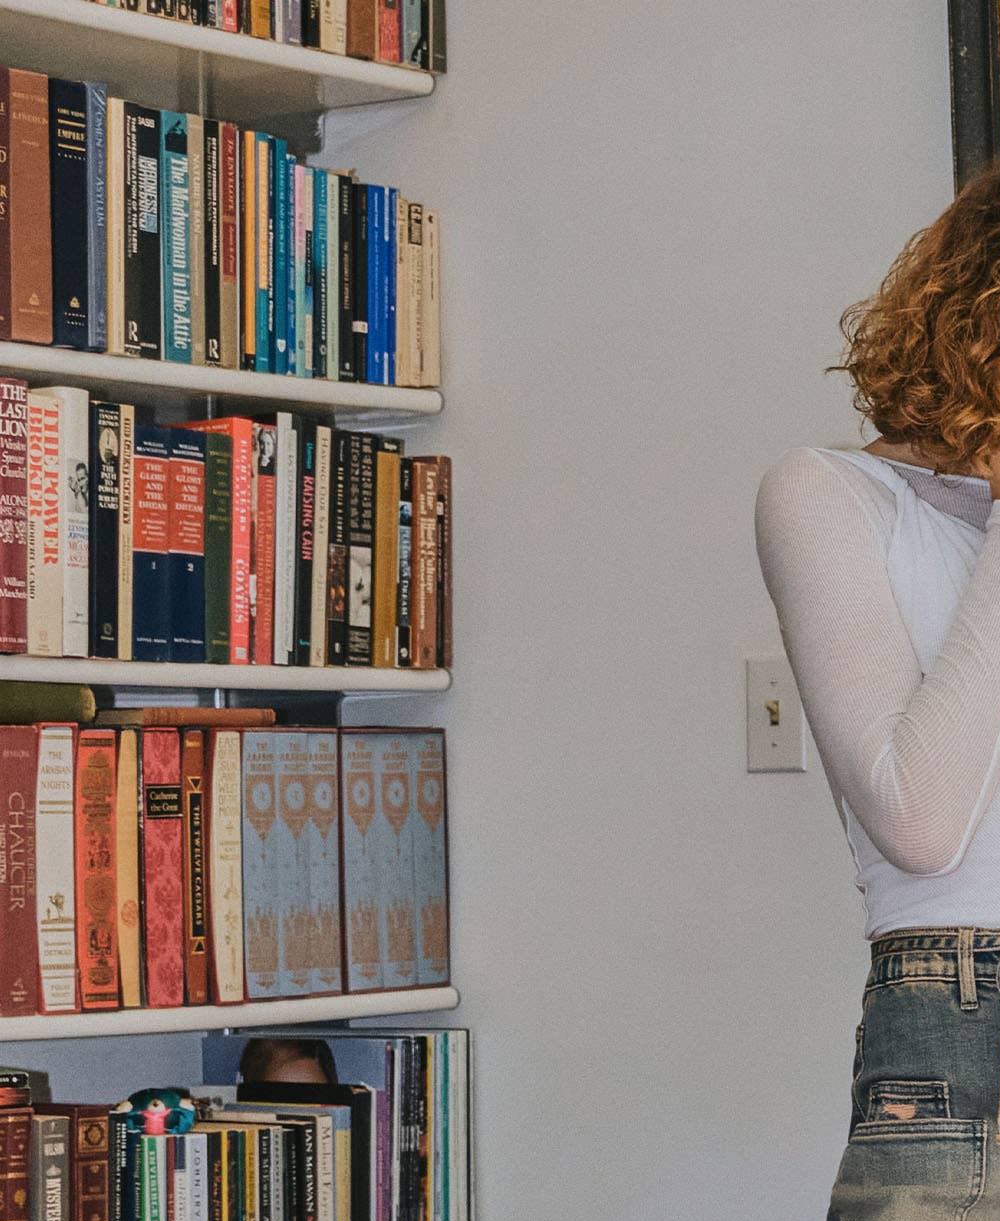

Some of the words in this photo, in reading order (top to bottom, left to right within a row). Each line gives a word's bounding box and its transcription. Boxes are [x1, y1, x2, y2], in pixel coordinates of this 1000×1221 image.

[58, 129, 86, 141] EMPIRE
[171, 157, 188, 182] The
[148, 159, 158, 214] MADNESS
[171, 186, 189, 268] Madwoman
[172, 272, 189, 286] in
[173, 289, 189, 310] the
[173, 313, 190, 349] Attic
[1, 384, 26, 402] THE
[0, 402, 27, 419] LAST
[0, 419, 27, 438] LION
[43, 403, 60, 466] THE
[29, 406, 44, 516] BROKER
[145, 463, 162, 472] THE
[182, 465, 198, 474] THE
[145, 482, 163, 491] AND
[176, 475, 201, 484] GLORY
[182, 484, 198, 493] AND
[145, 491, 163, 500] THE
[182, 494, 198, 502] THE
[302, 475, 314, 527] RAISING
[43, 471, 60, 566] POWER
[175, 503, 203, 513] DREAM
[302, 530, 314, 560] CAIN
[187, 562, 194, 572] 2
[426, 550, 437, 594] Culture
[234, 558, 245, 624] COATES
[48, 752, 62, 761] THE
[41, 781, 71, 790] NIGHTS
[149, 791, 179, 800] Catherine
[150, 802, 162, 812] the
[162, 802, 179, 812] Great
[8, 792, 26, 913] CHAUCER
[193, 830, 201, 873] TWELVE
[194, 876, 203, 926] CAESARS
[305, 1128, 314, 1152] IAN
[321, 1126, 331, 1176] Michael
[193, 1148, 202, 1187] JOHN
[148, 1150, 159, 1217] INVISIBLE
[305, 1156, 315, 1212] McEWAN
[320, 1182, 331, 1217] Frayn
